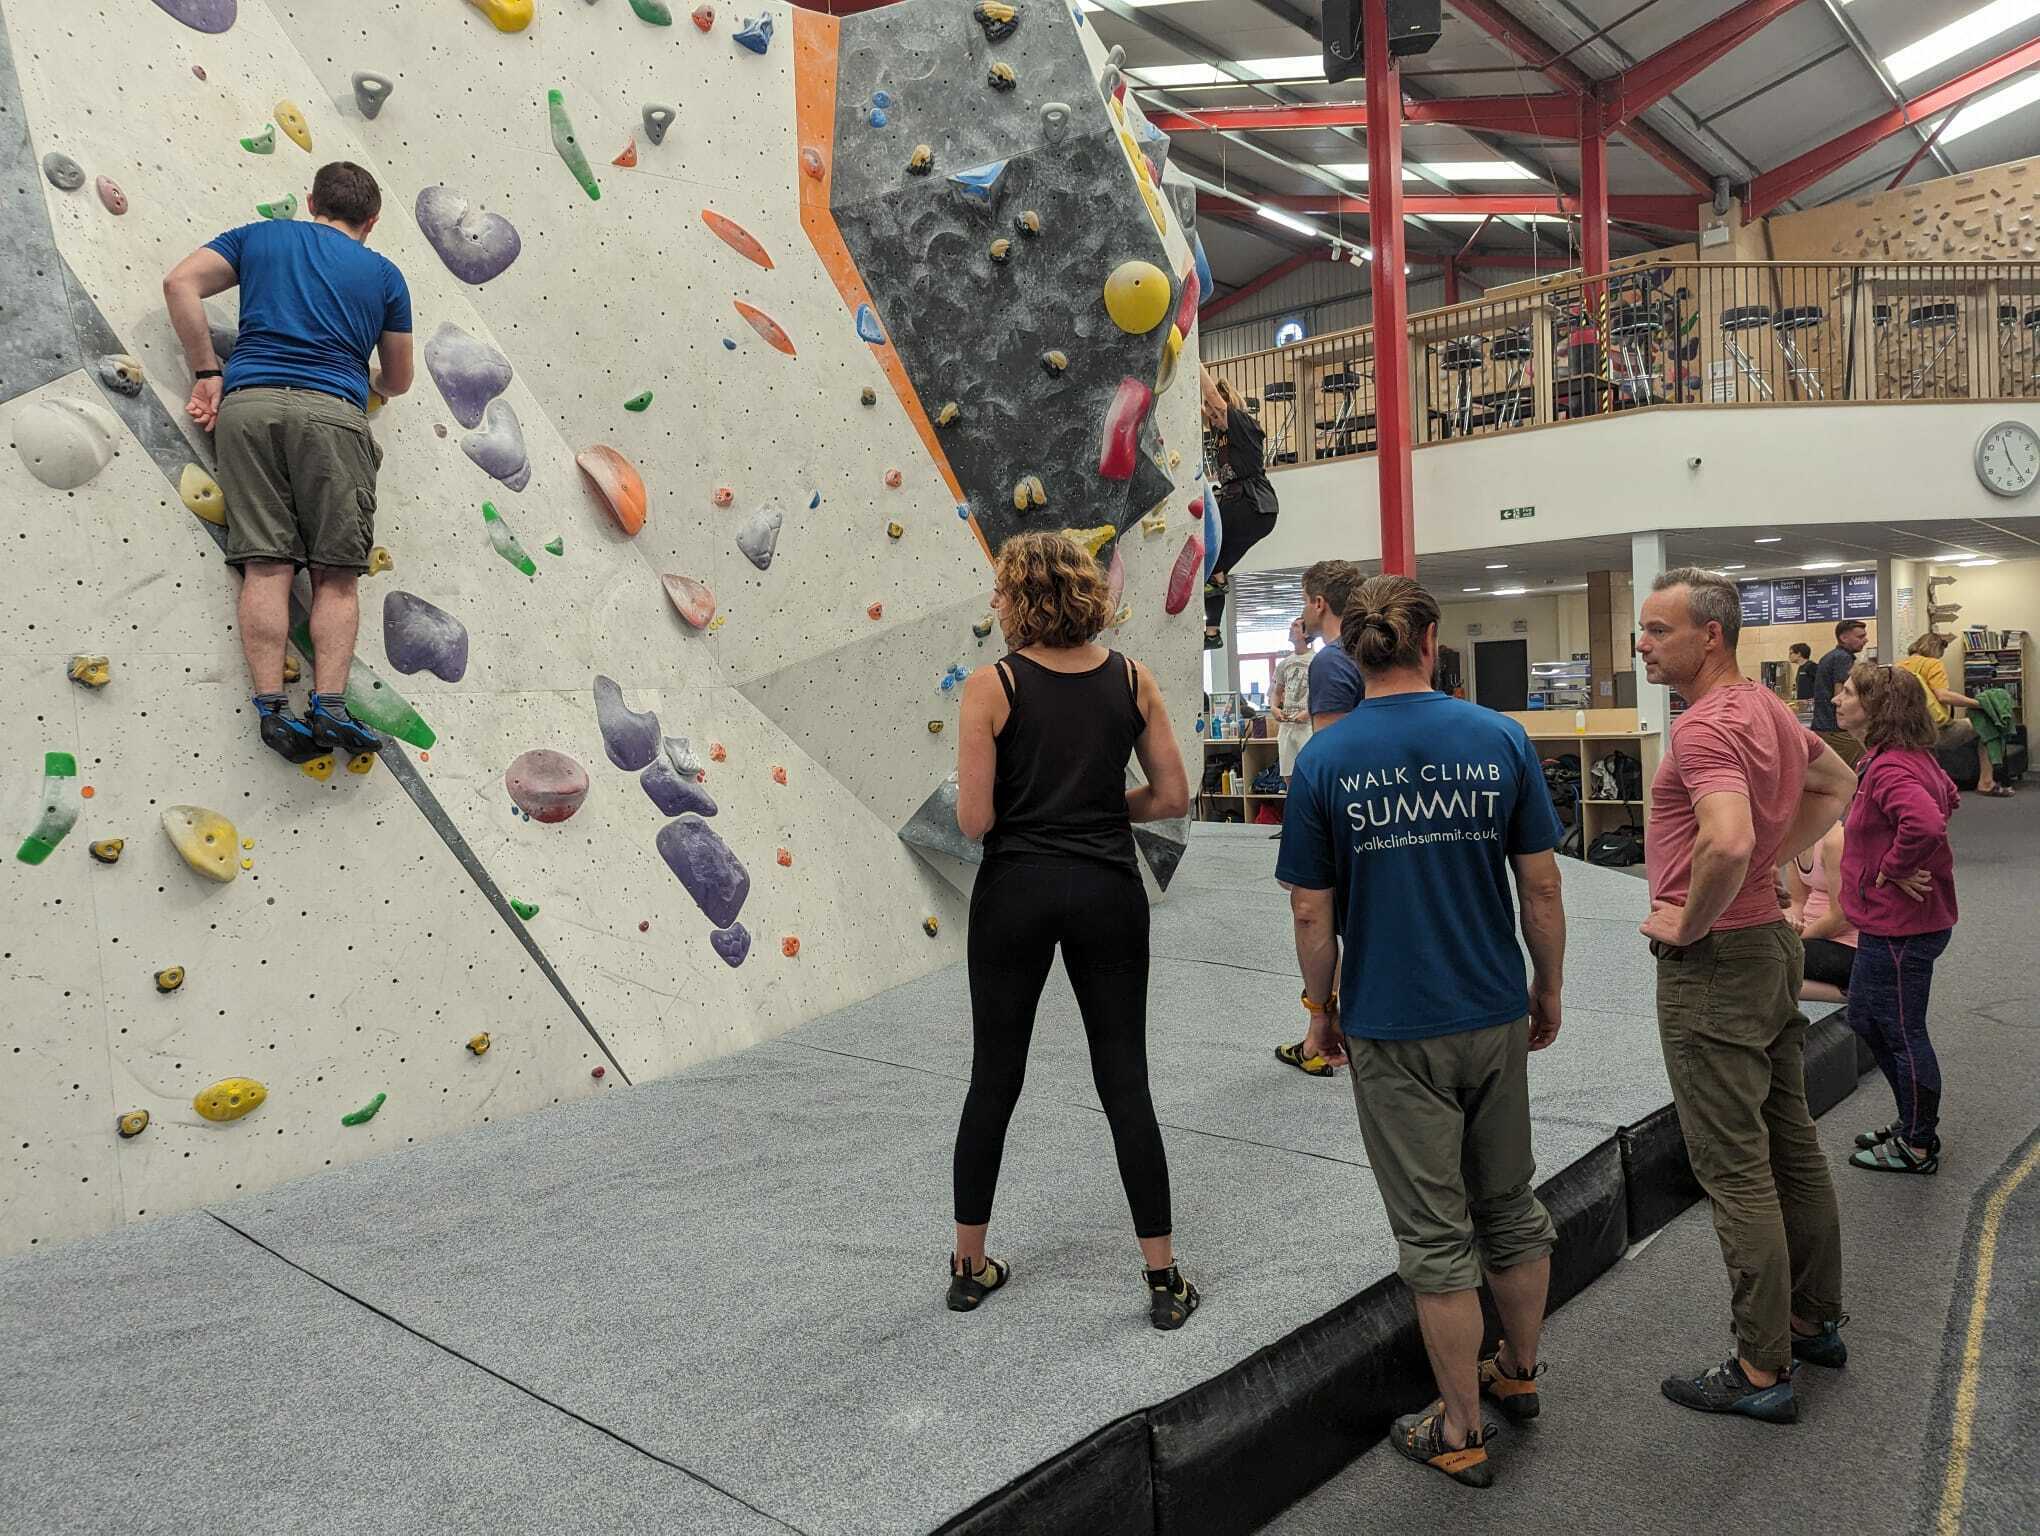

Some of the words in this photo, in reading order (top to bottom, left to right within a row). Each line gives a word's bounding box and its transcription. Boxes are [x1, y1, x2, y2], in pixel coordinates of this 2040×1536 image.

[1339, 767, 1409, 793] WALK
[1420, 763, 1501, 782] CLIMB
[1346, 788, 1501, 831] SUMMIT
[1353, 827, 1499, 855] walkclimbsummit.co.uk
